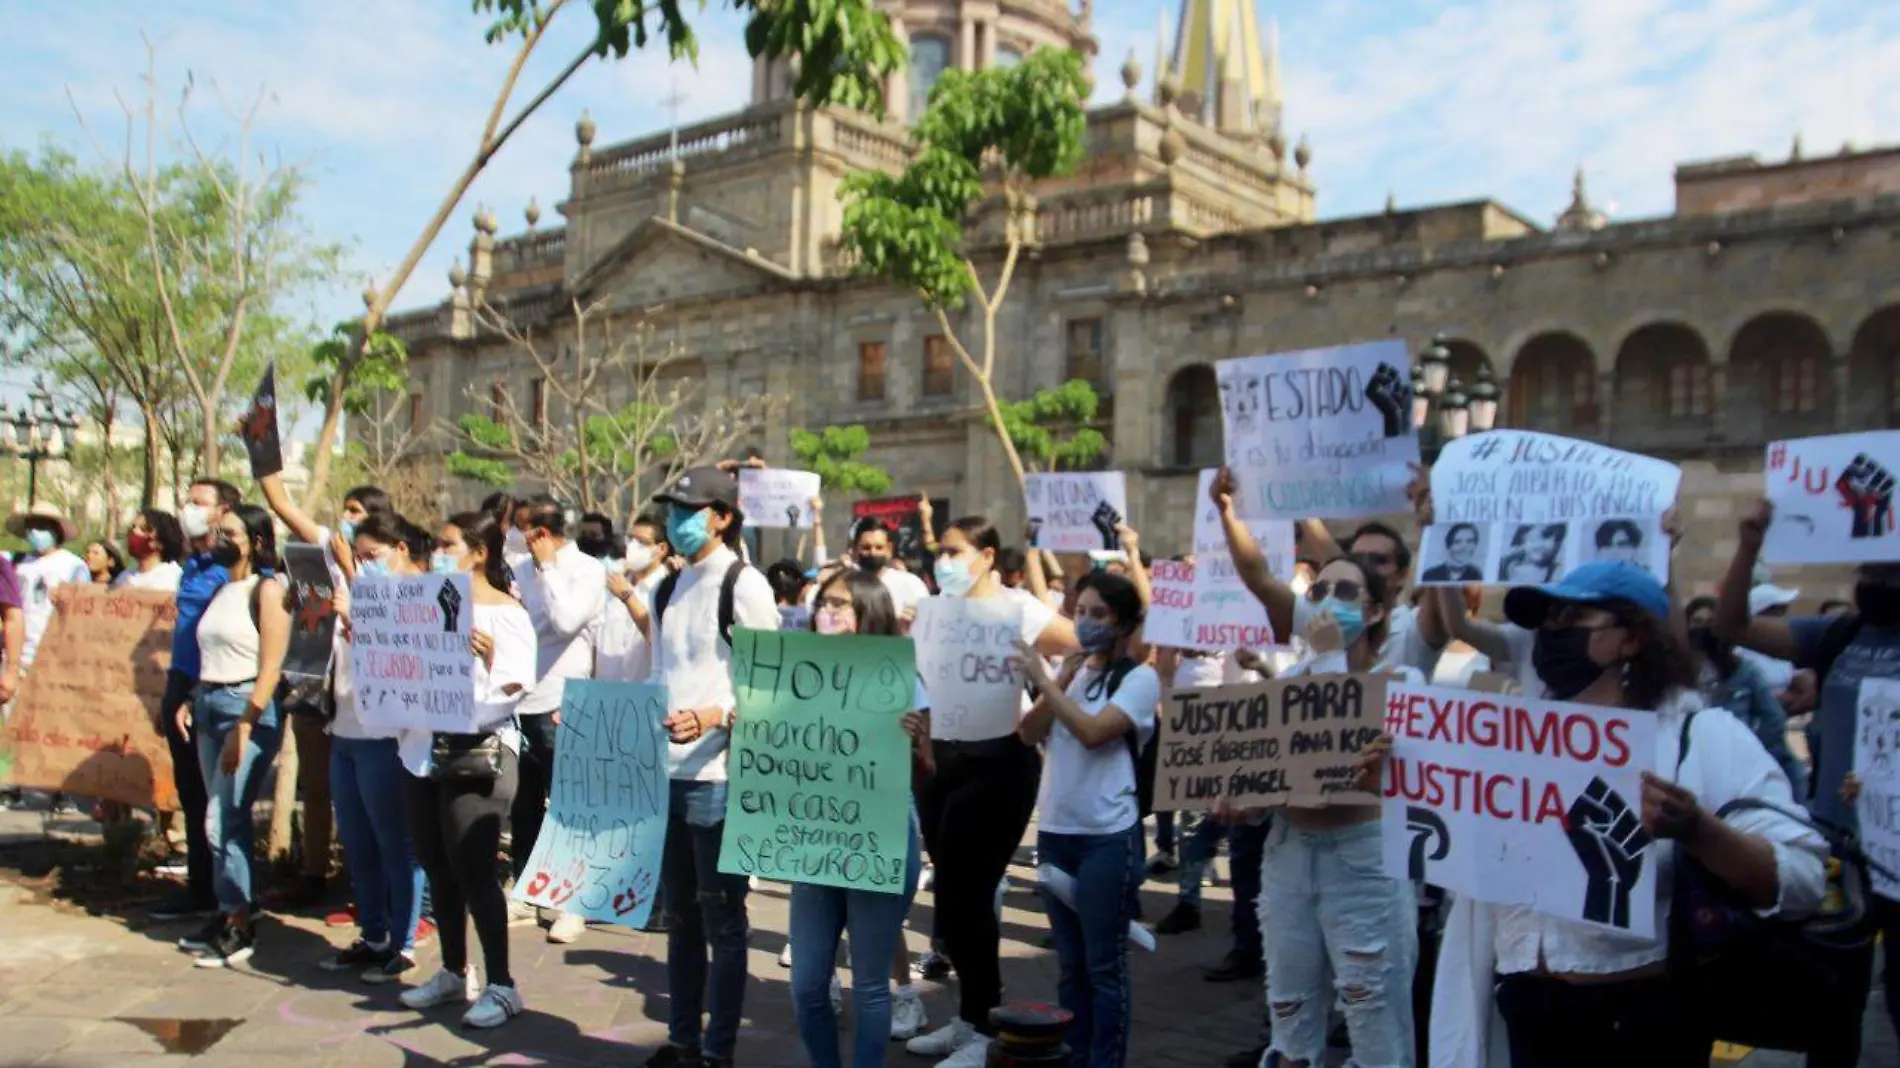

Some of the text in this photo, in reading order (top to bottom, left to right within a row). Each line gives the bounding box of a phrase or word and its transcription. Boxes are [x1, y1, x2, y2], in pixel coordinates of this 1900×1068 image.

[1264, 366, 1364, 421] ESTADO
[1196, 623, 1272, 647] JUSTICIA
[960, 652, 1015, 686] CASA
[1171, 678, 1364, 735] JUSTICIA PARA
[742, 716, 859, 757] marcho
[1290, 731, 1333, 755] ANA
[1382, 691, 1631, 768] #EXIGIMOS
[847, 760, 877, 791] ni
[1168, 775, 1179, 799] Y
[1186, 775, 1222, 799] LUIS
[740, 789, 862, 825] en casa
[1383, 756, 1573, 833] JUSTICIA
[775, 824, 879, 853] estamos
[579, 864, 612, 910] 3
